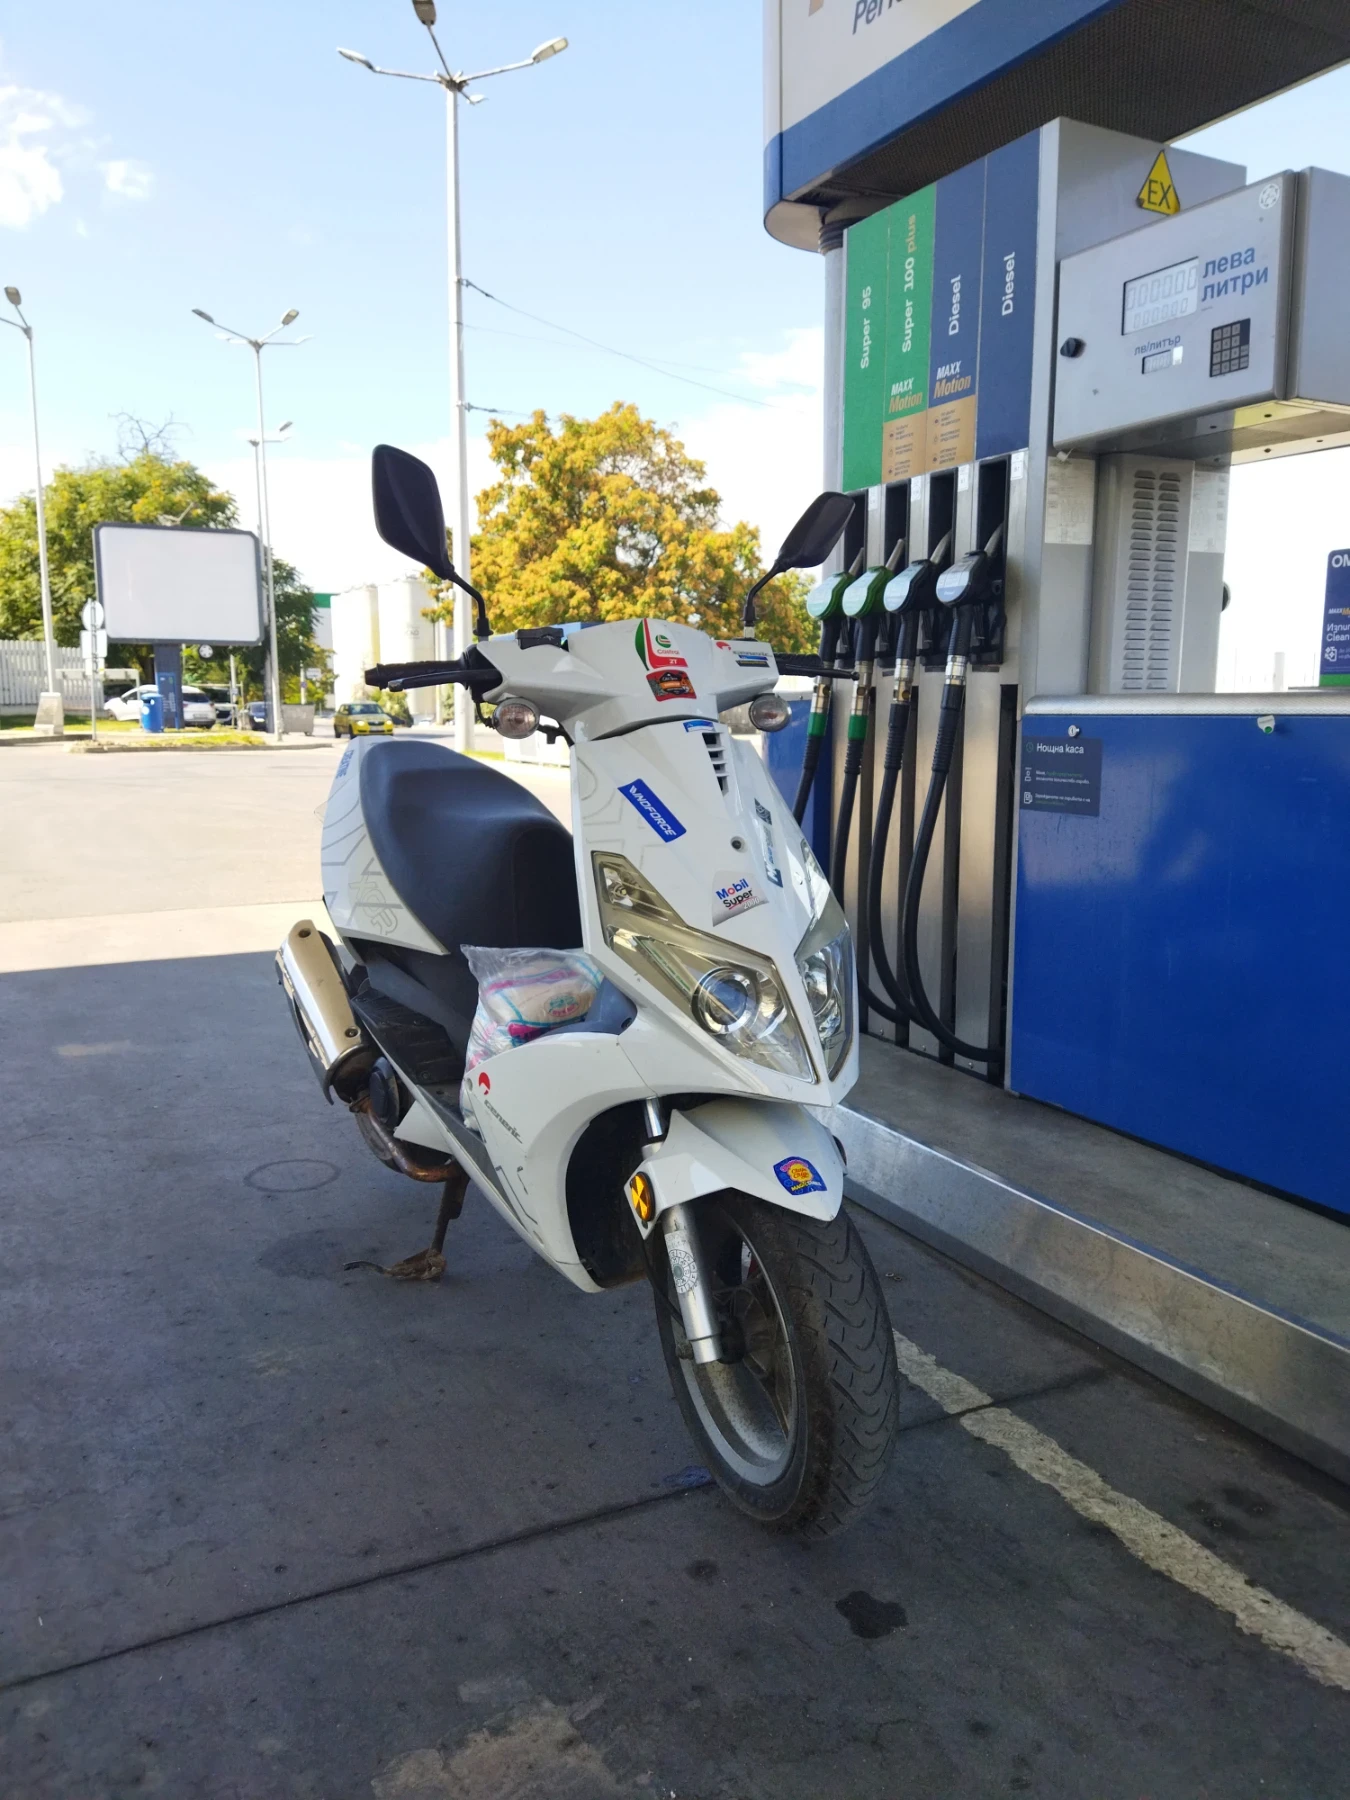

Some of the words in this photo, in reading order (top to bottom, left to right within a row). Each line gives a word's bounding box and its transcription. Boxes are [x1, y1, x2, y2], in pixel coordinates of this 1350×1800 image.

[1147, 179, 1172, 210] EX
[906, 214, 917, 253] plus
[904, 257, 915, 292] 100
[1203, 247, 1255, 279] лева
[1001, 251, 1015, 316] Diesel
[1201, 266, 1268, 302] литри
[862, 286, 871, 310] 95
[948, 273, 961, 336] Diesel
[902, 299, 914, 353] Super
[860, 318, 872, 369] Super
[1134, 335, 1181, 356] лв/литър
[936, 360, 962, 381] MAXX
[890, 377, 915, 397] MAXX
[933, 375, 972, 400] Motion
[888, 391, 923, 414] Motion
[1036, 742, 1064, 754] Нощна
[1065, 744, 1085, 754] каса
[715, 878, 749, 900] Mobil
[723, 889, 753, 908] Super
